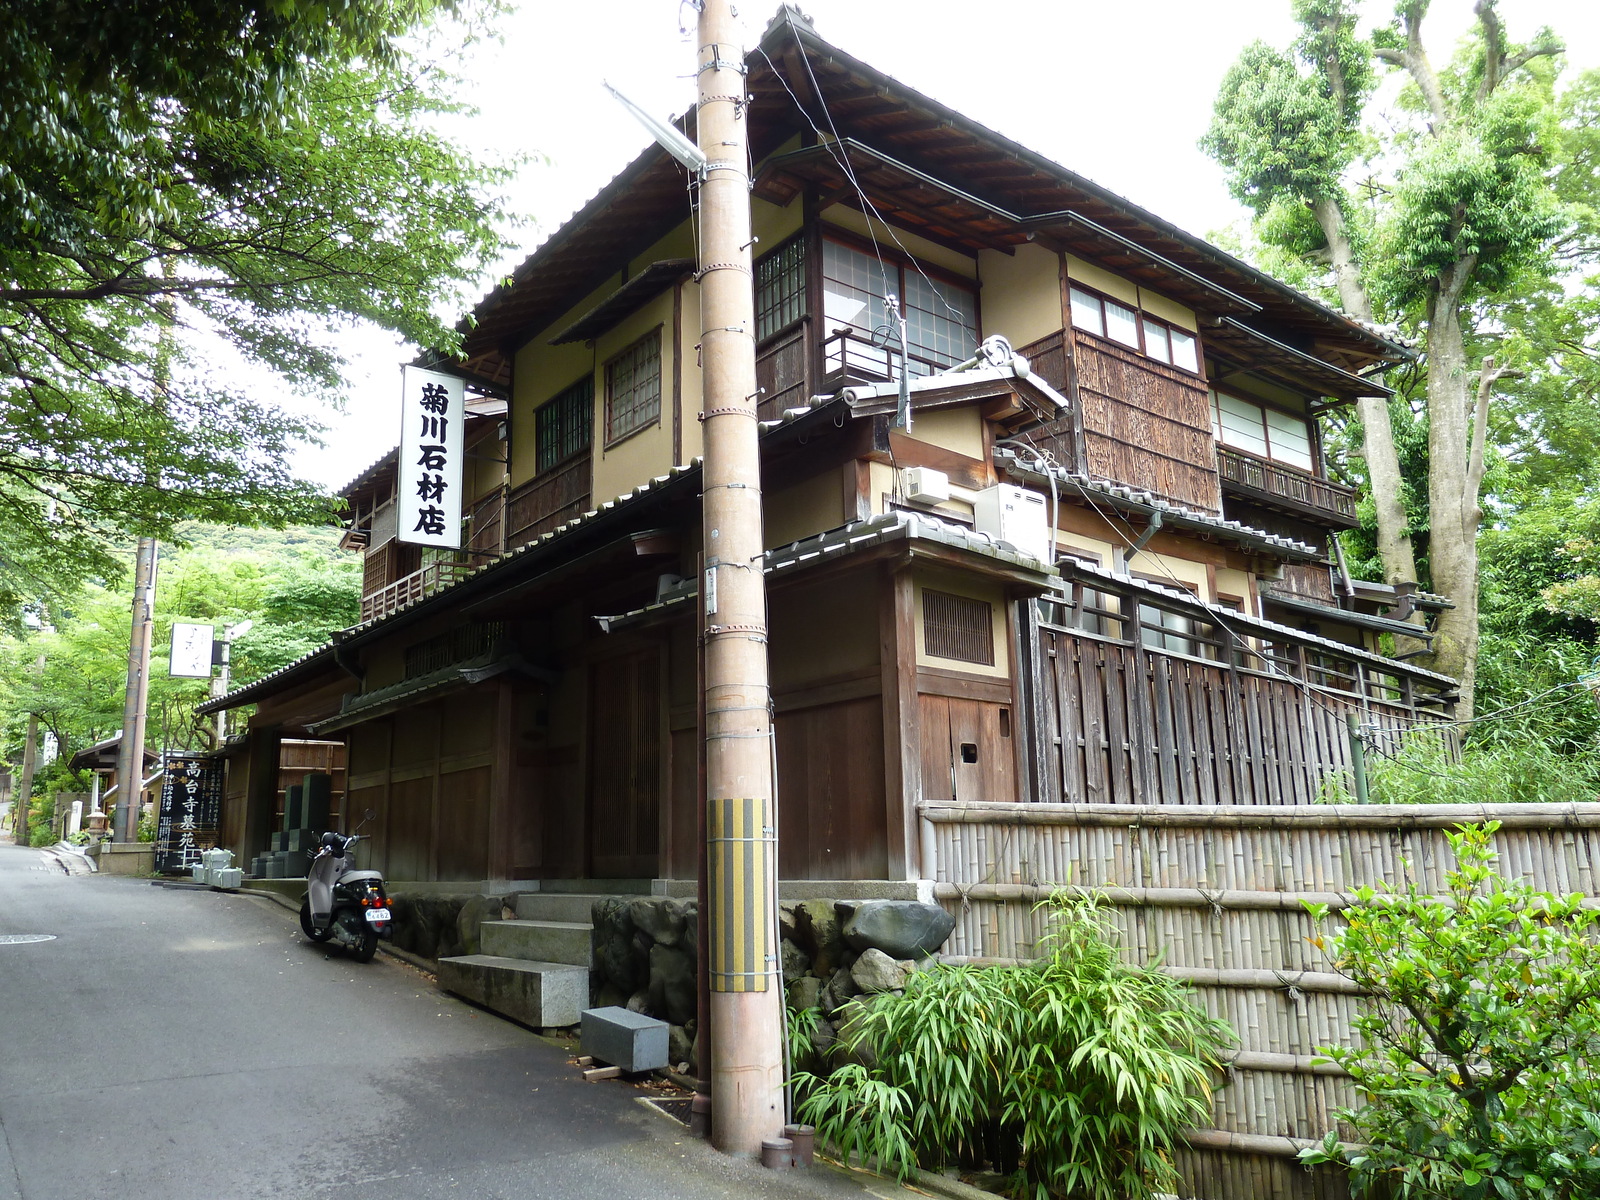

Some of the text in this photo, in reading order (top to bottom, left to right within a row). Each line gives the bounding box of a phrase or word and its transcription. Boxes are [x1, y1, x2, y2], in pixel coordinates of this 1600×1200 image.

[413, 382, 449, 536] 菊川石材店
[179, 761, 201, 848] 高台寺墓苑
